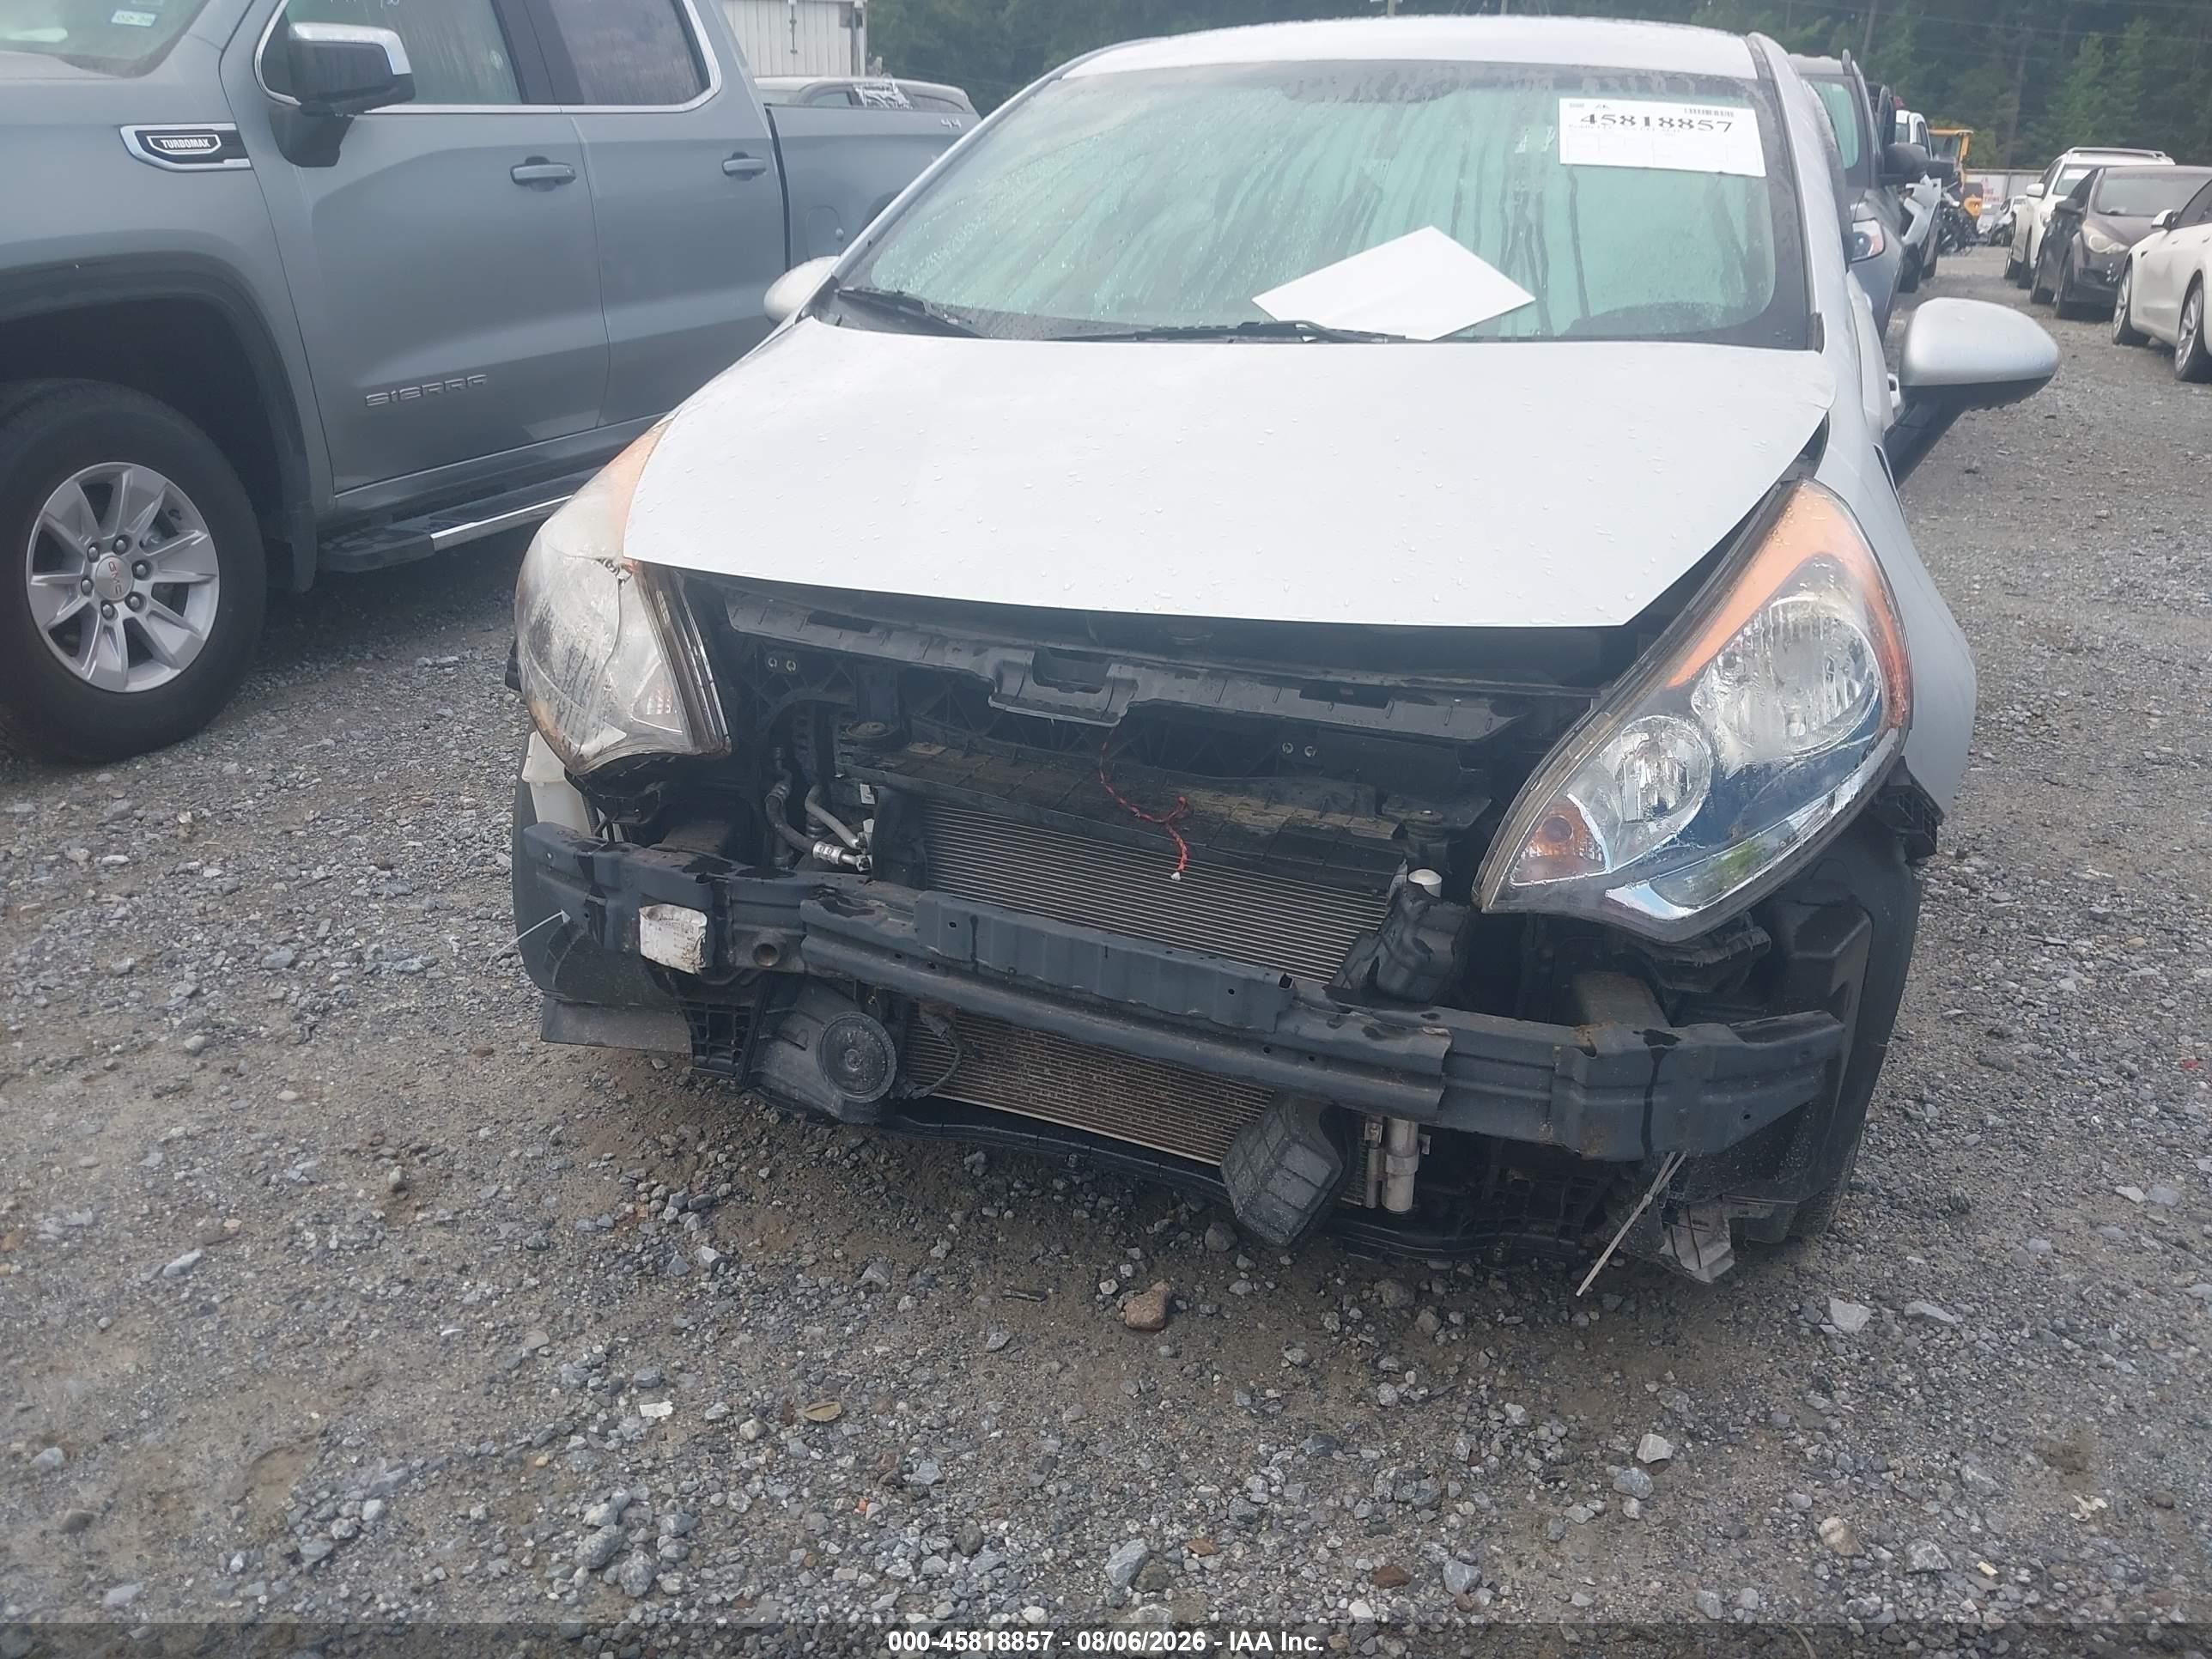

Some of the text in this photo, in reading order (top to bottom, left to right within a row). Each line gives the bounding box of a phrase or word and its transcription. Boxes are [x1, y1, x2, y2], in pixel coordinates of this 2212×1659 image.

[1580, 112, 1733, 133] 45818857
[160, 138, 211, 149] TURBOMAX
[365, 374, 488, 407] SIERRA
[108, 561, 123, 595] GMC
